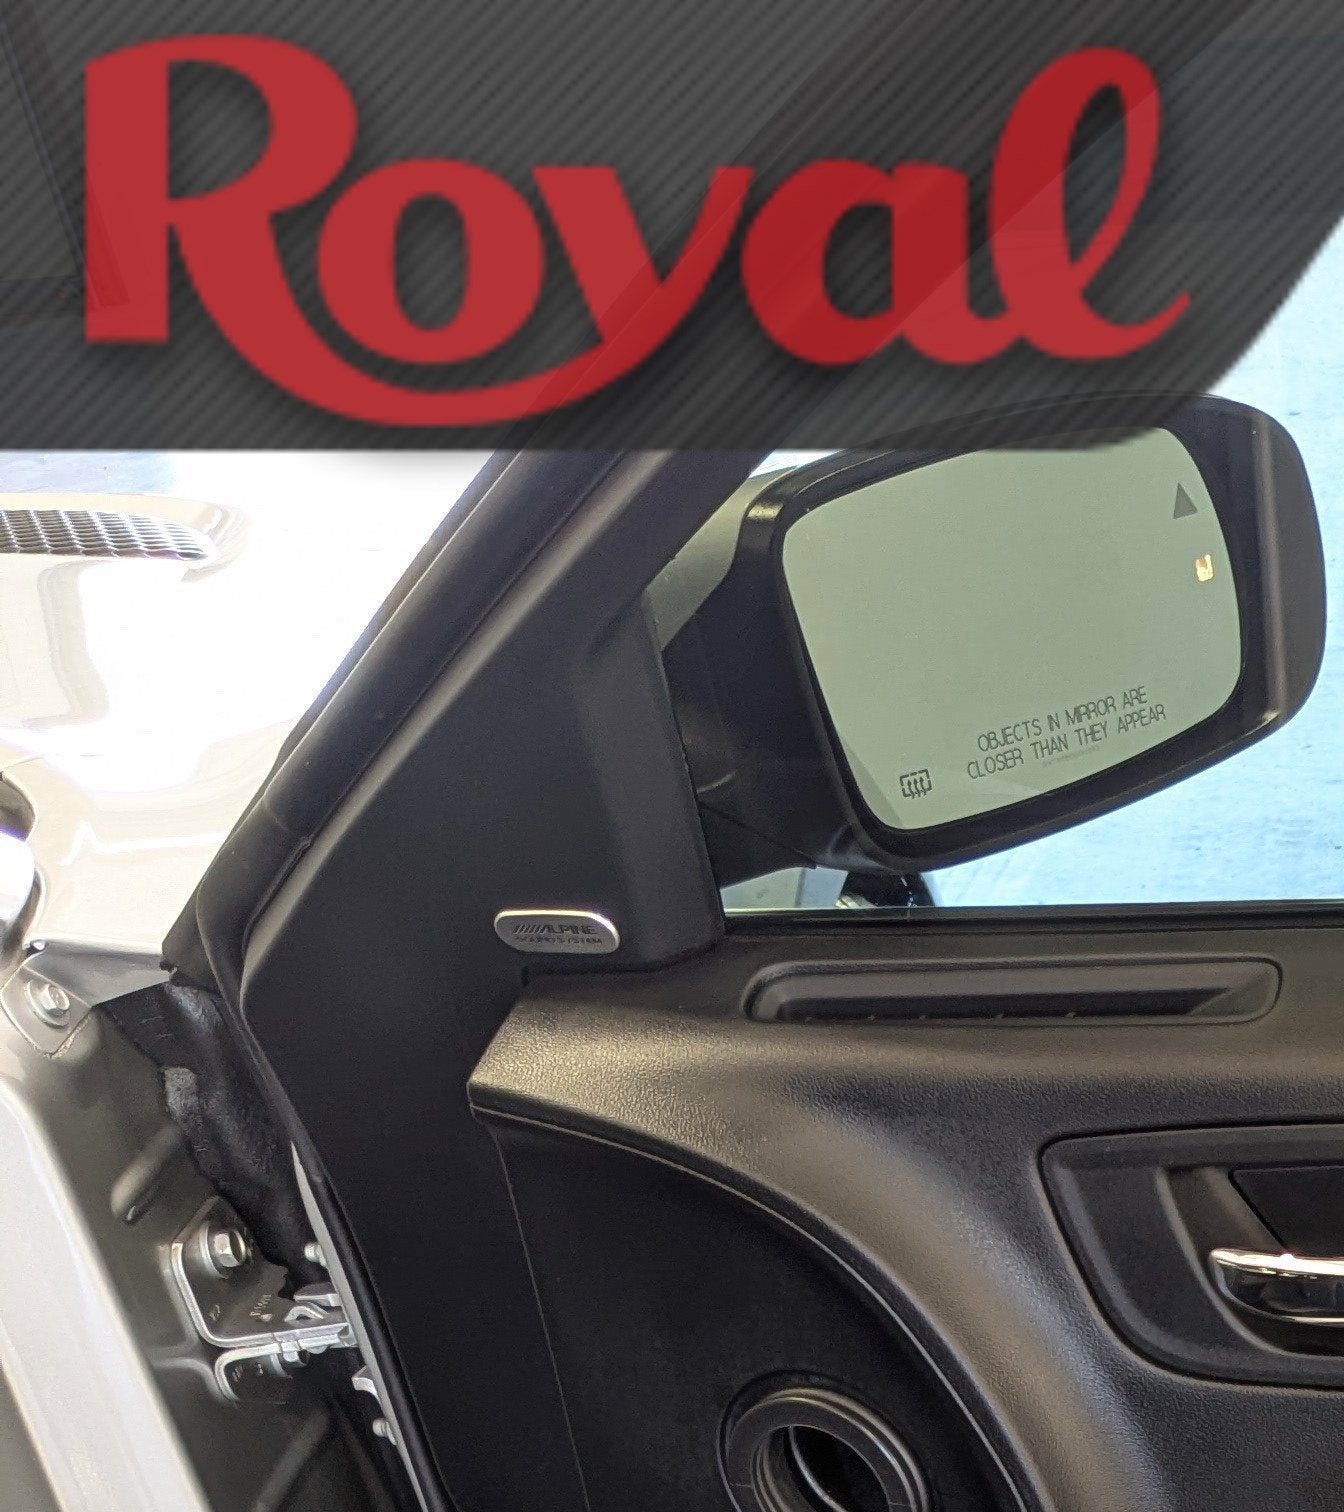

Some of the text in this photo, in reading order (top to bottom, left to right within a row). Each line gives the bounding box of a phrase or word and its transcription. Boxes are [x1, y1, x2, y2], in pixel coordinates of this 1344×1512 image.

[967, 749, 1024, 780] CLOSER
[1031, 737, 1070, 761] THAN
[1075, 722, 1109, 745] THEY
[1118, 703, 1166, 734] APPEAR
[978, 685, 1148, 752] OBJECTS IN MIRROR ARE
